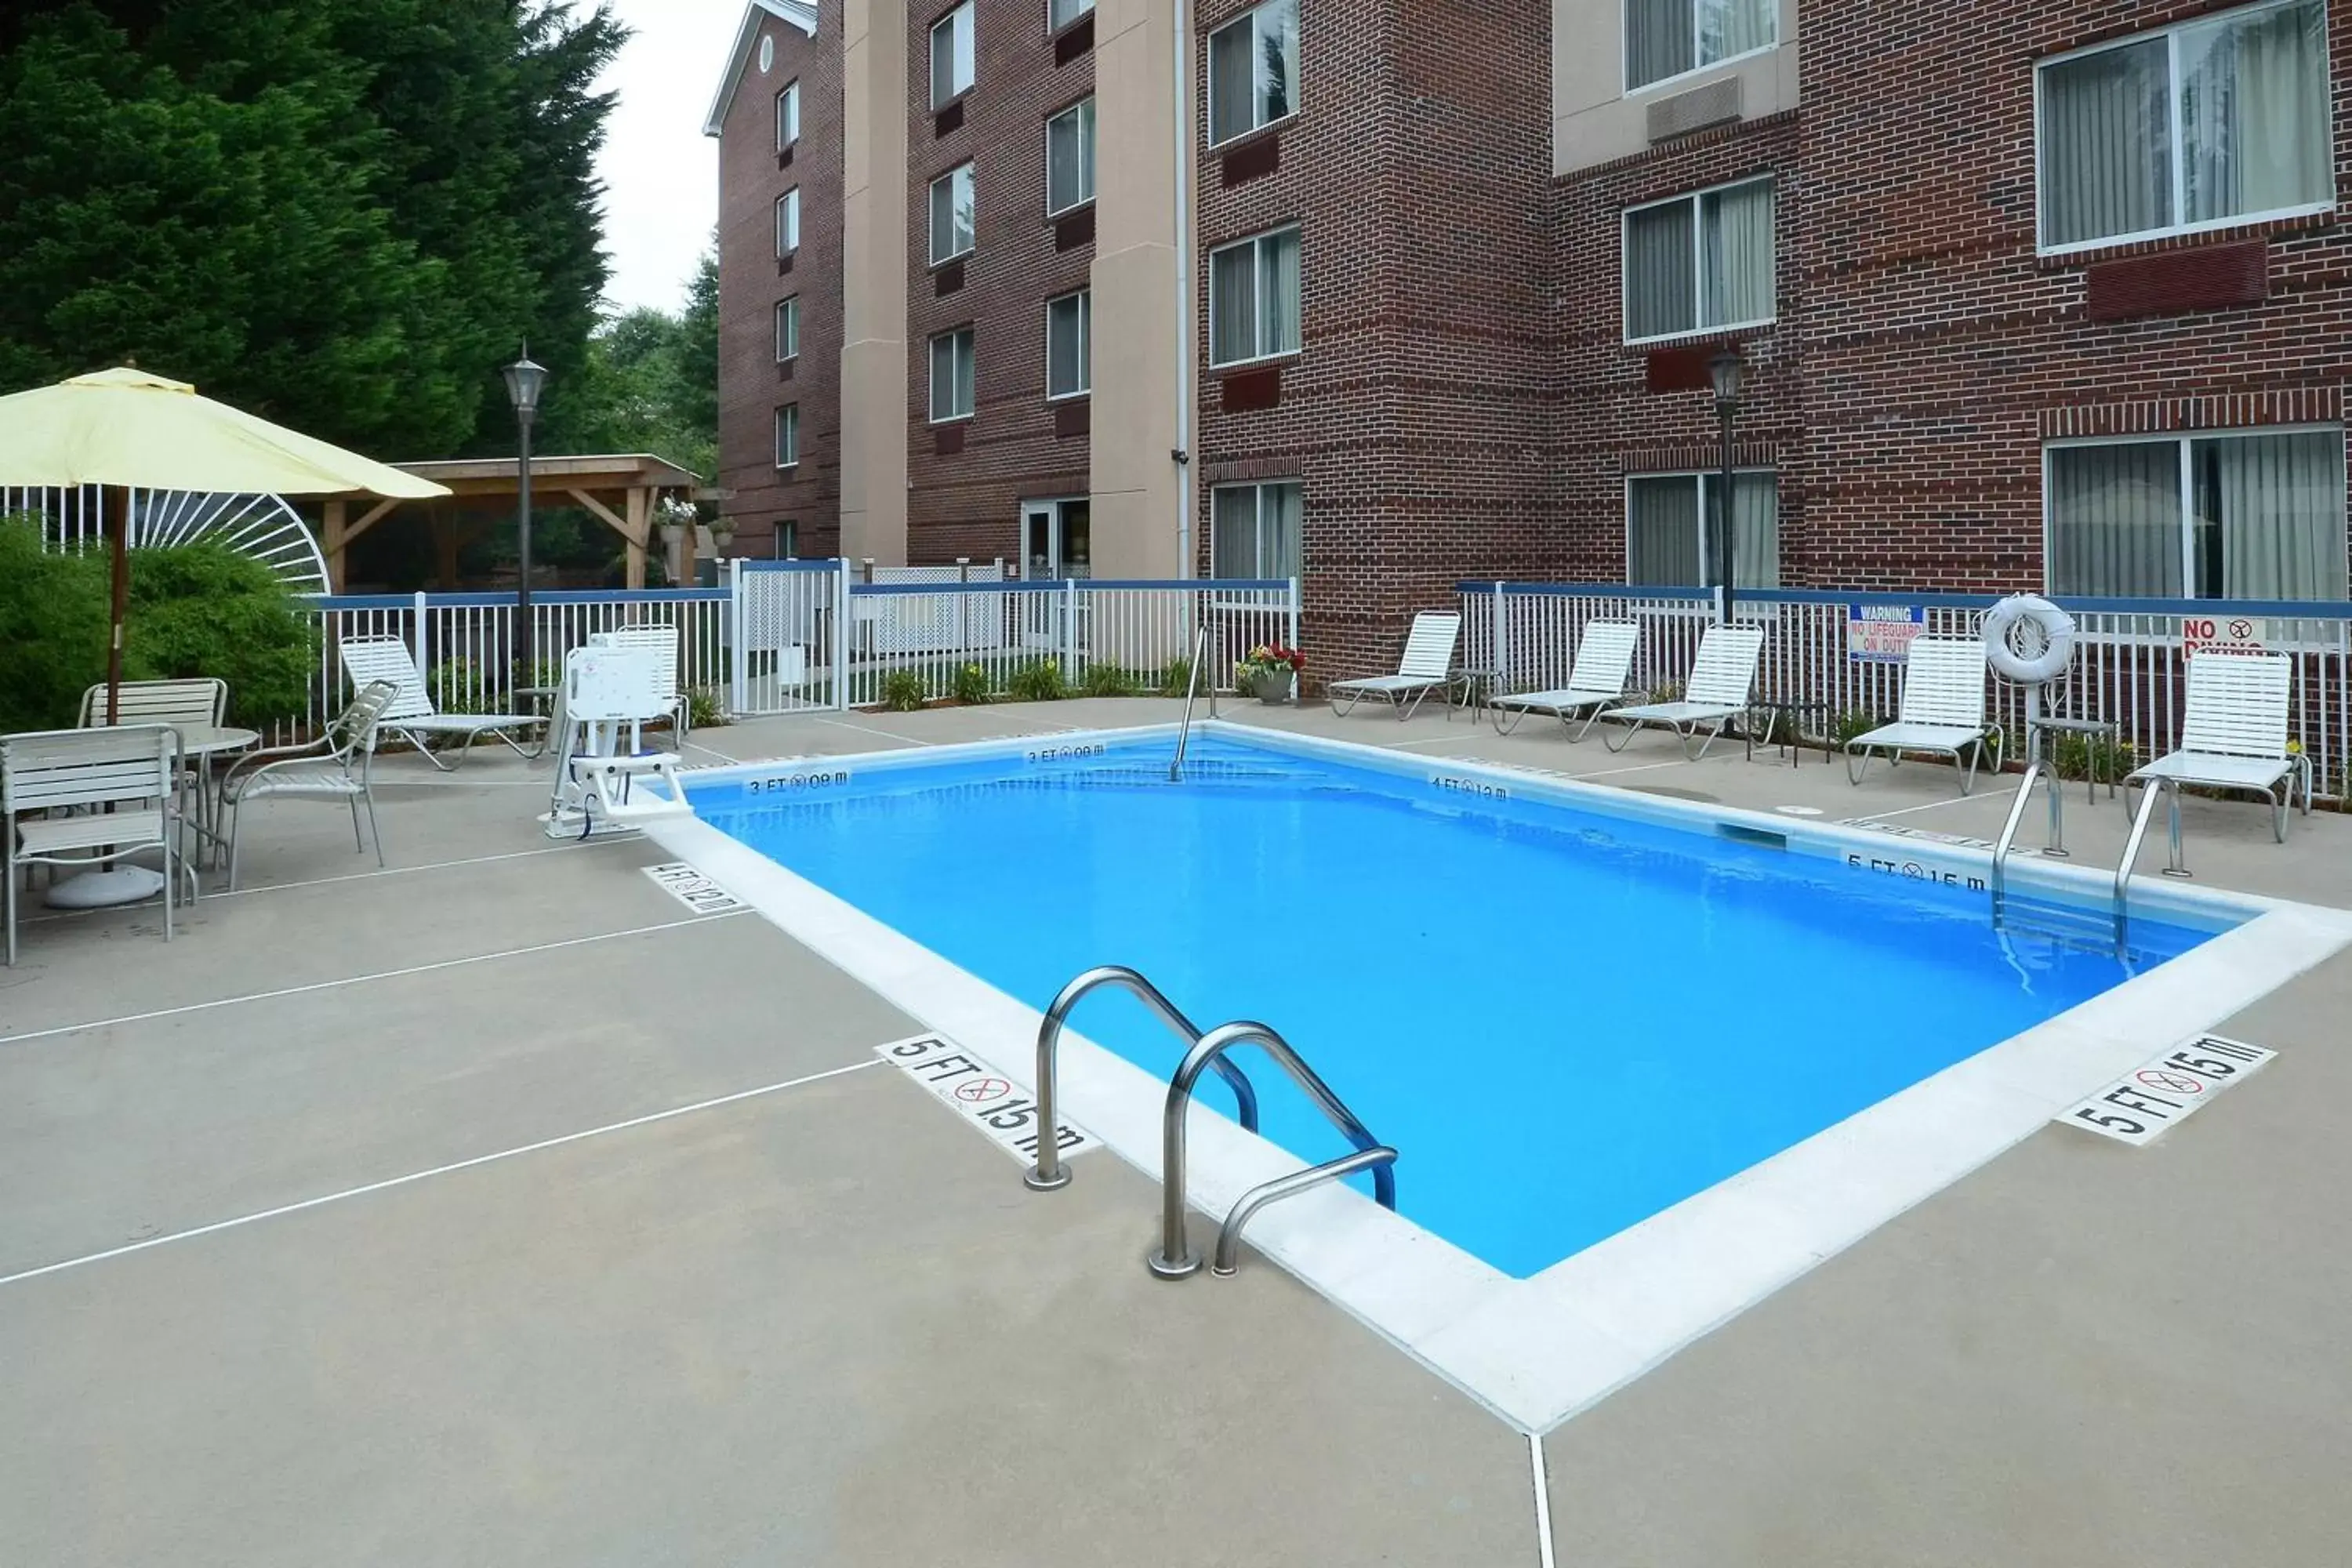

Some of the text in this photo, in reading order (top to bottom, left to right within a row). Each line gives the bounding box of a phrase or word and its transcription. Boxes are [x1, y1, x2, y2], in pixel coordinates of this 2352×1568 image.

[1860, 605, 1911, 621] WARNING
[1851, 622, 1921, 637] NO LIFEGUARD
[2184, 620, 2216, 639] NO
[1864, 637, 1909, 652] ON DUTY
[1848, 854, 1860, 867] 5
[1967, 877, 1985, 891] m
[892, 1039, 946, 1057] 5
[2190, 1037, 2264, 1062] m
[914, 1054, 982, 1082] FT
[2103, 1086, 2183, 1119] FT
[2074, 1108, 2146, 1134] 5
[1014, 1125, 1085, 1158] m
